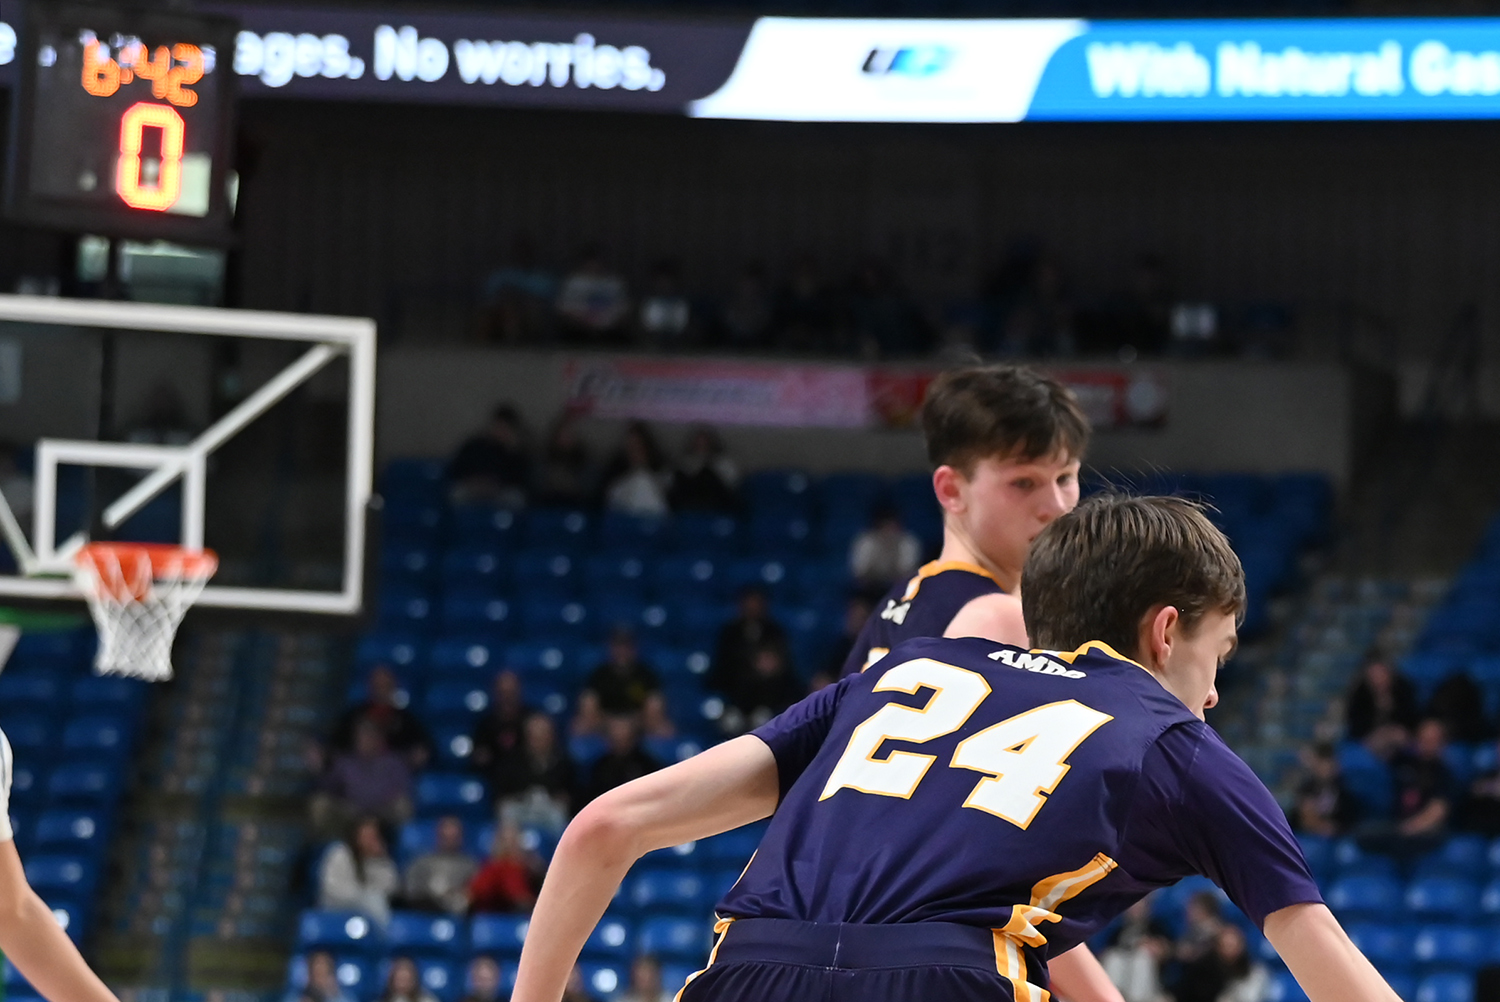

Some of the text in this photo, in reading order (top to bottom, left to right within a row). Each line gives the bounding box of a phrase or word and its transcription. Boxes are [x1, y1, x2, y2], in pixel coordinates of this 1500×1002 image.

[374, 24, 449, 82] No
[454, 32, 666, 92] worries.
[1086, 41, 1211, 98] With
[1215, 40, 1402, 97] Natural
[116, 102, 185, 211] 0
[819, 658, 1114, 831] 24
